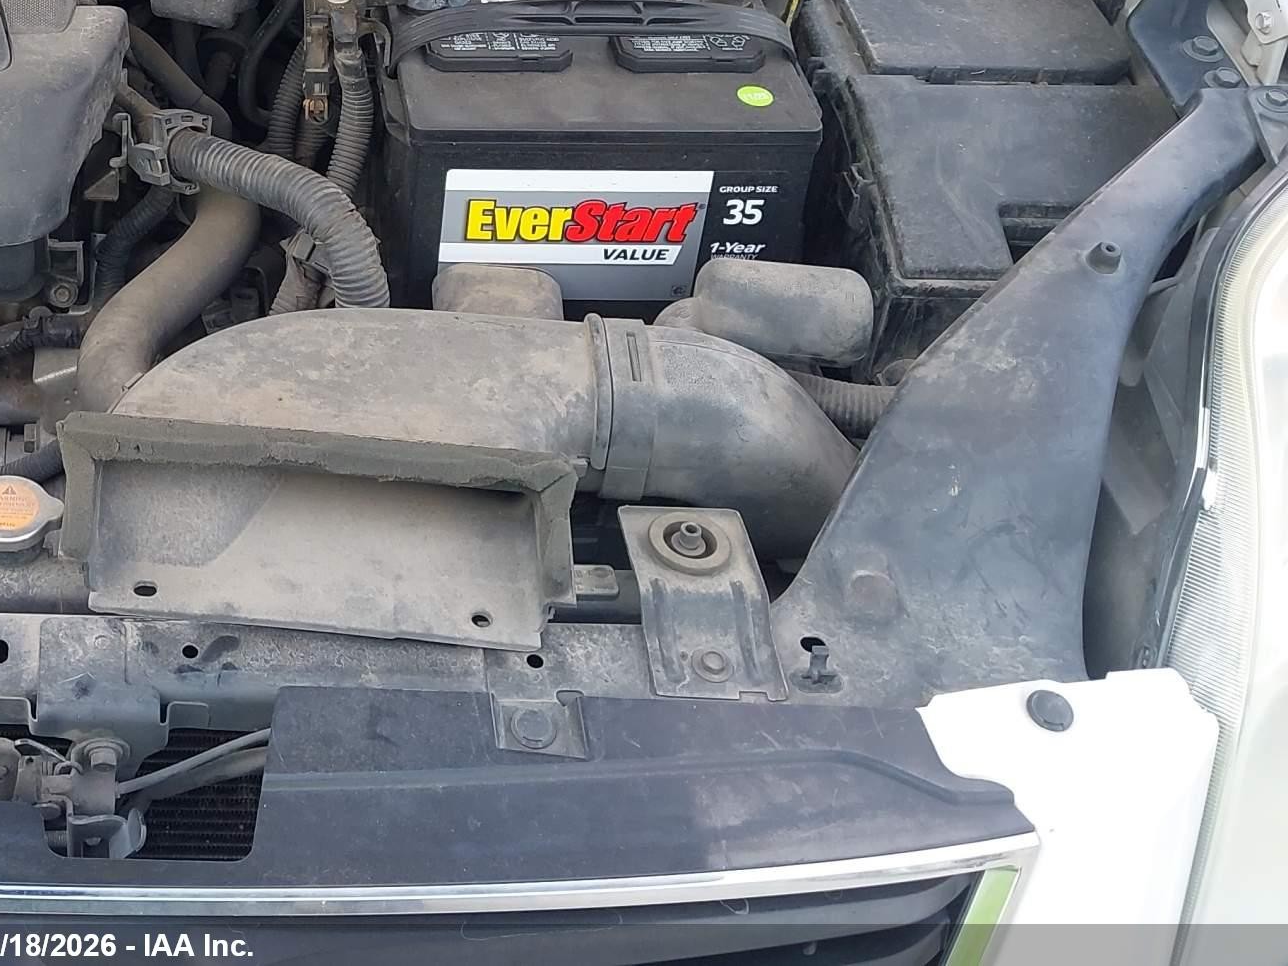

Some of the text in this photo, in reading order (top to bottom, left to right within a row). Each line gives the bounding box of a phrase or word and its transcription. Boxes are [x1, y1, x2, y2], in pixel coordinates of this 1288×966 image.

[465, 198, 701, 243] EverStart
[722, 199, 765, 225] 35
[602, 247, 669, 261] VALUE
[710, 242, 766, 254] 1-Year
